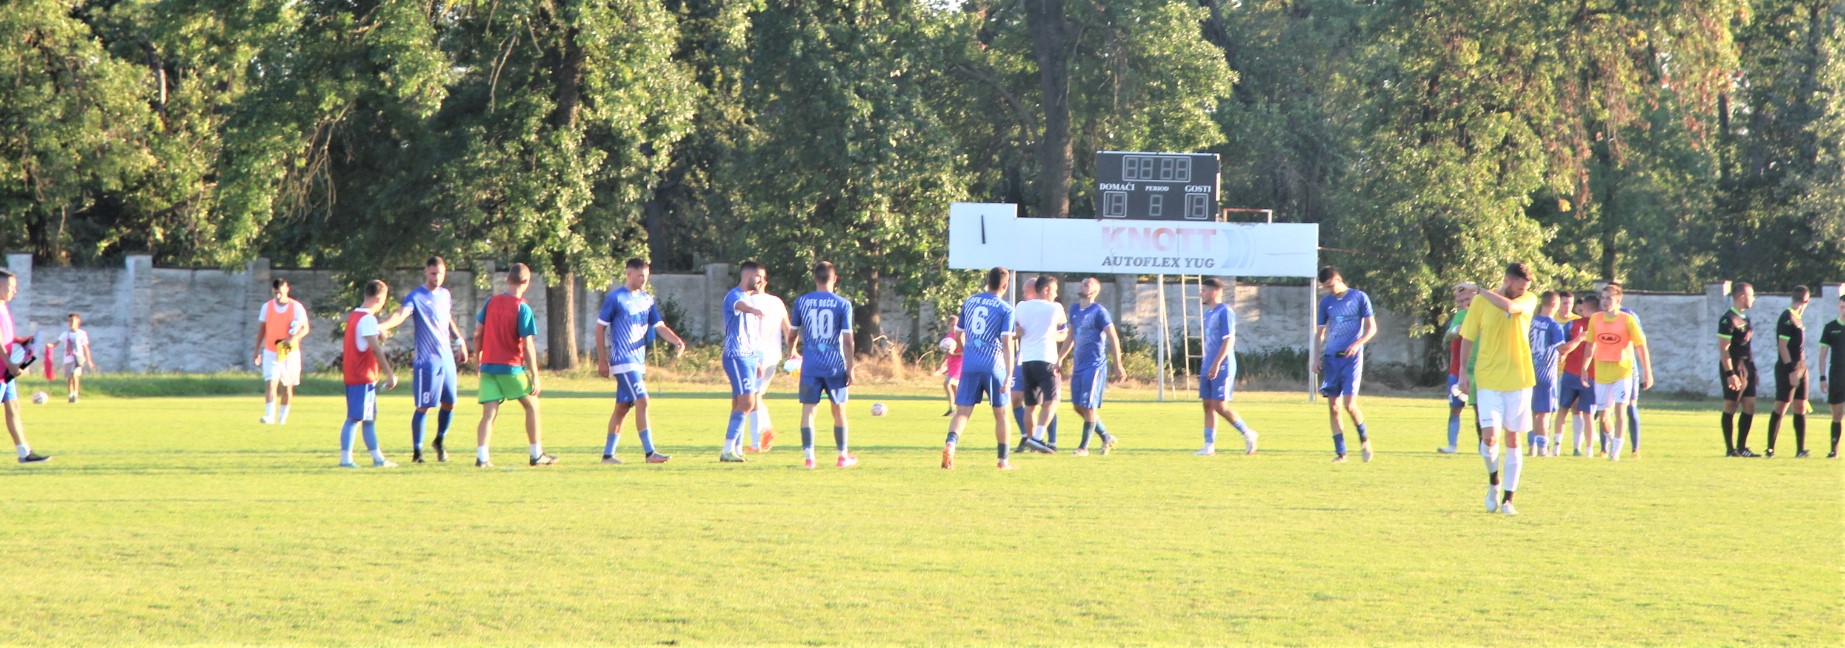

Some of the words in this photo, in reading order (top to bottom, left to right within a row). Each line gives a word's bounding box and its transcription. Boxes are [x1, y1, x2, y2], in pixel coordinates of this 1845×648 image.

[1099, 182, 1135, 191] DOMAĆI
[1185, 185, 1212, 193] GOSTI
[1102, 227, 1217, 251] KNOTT
[1101, 256, 1180, 268] AUTOFLEX
[1182, 258, 1215, 268] YUG
[808, 308, 834, 339] 10
[971, 305, 989, 335] 6
[423, 391, 430, 404] 8
